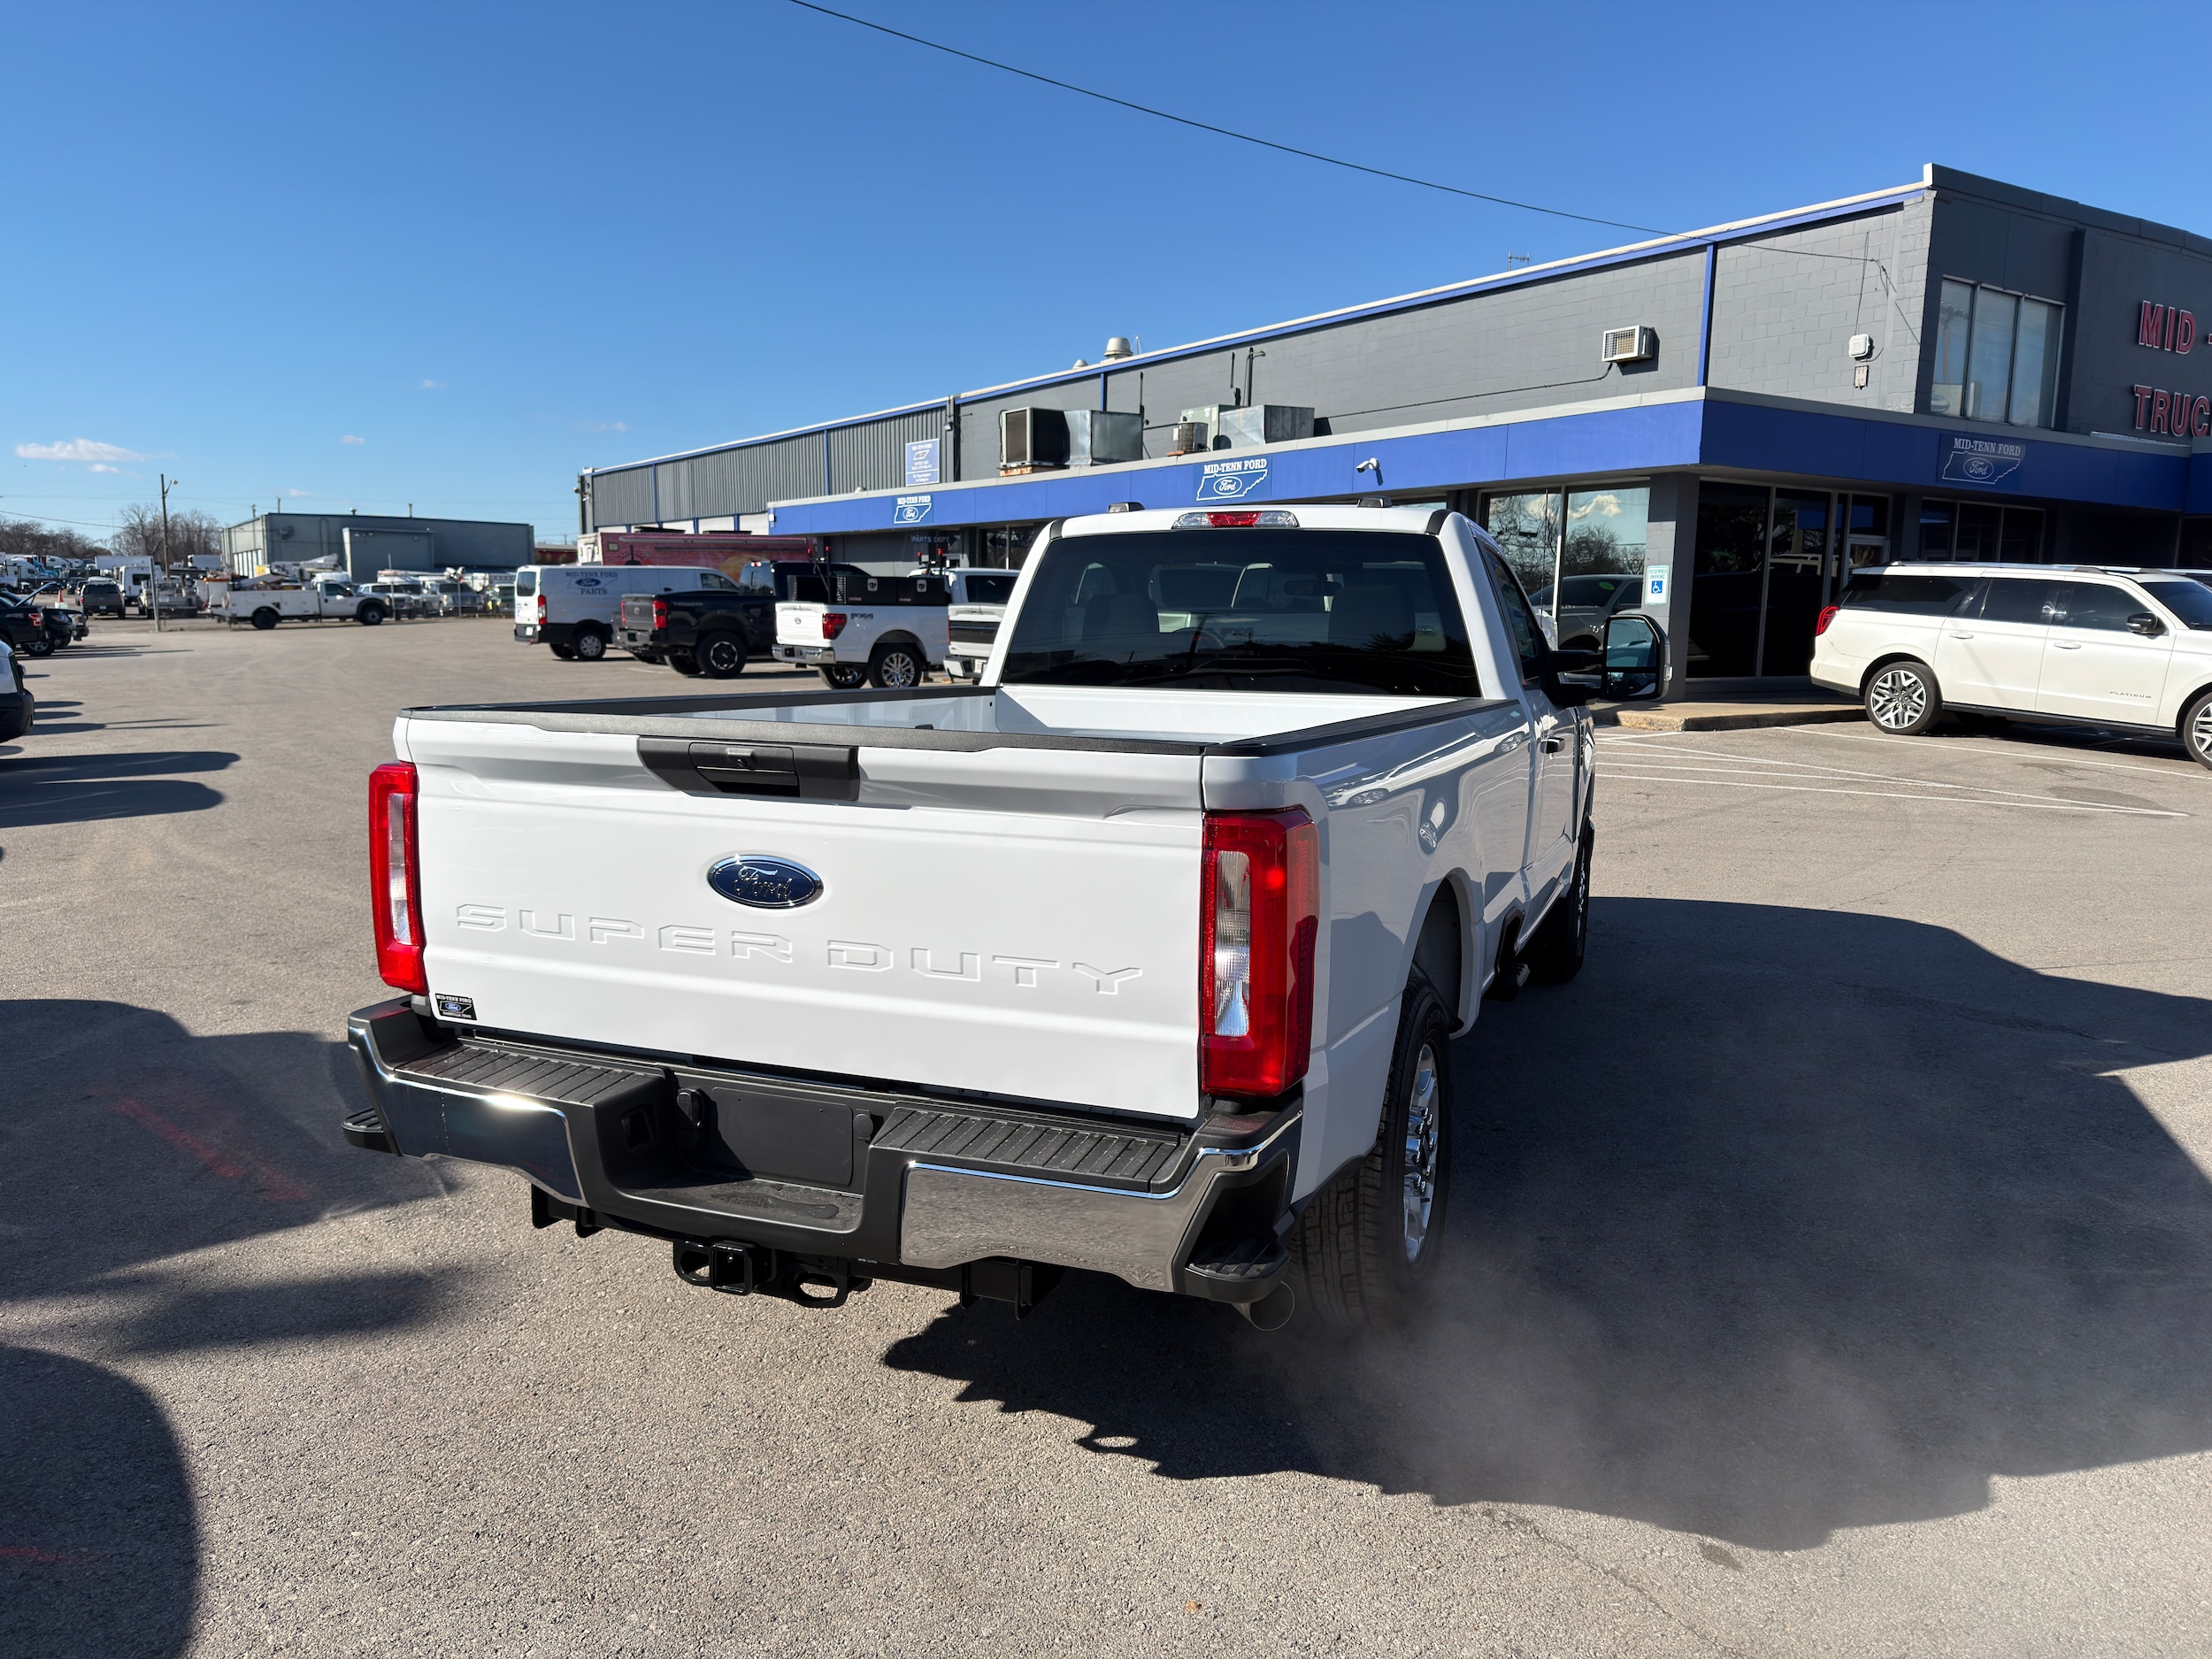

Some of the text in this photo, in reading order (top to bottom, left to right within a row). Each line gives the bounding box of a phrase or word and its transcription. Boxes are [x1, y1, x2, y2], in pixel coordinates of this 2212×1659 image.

[2139, 300, 2197, 355] MID
[2133, 384, 2212, 437] TRUC
[1953, 437, 2021, 456] MID-TENN FORD
[1203, 458, 1267, 474] MID-TENN FORD
[1969, 460, 1988, 475] Ford
[1218, 479, 1237, 491] Ford
[2109, 690, 2152, 699] PLATINUM
[733, 865, 793, 899] Ford
[457, 903, 1142, 995] SUPER DUTY
